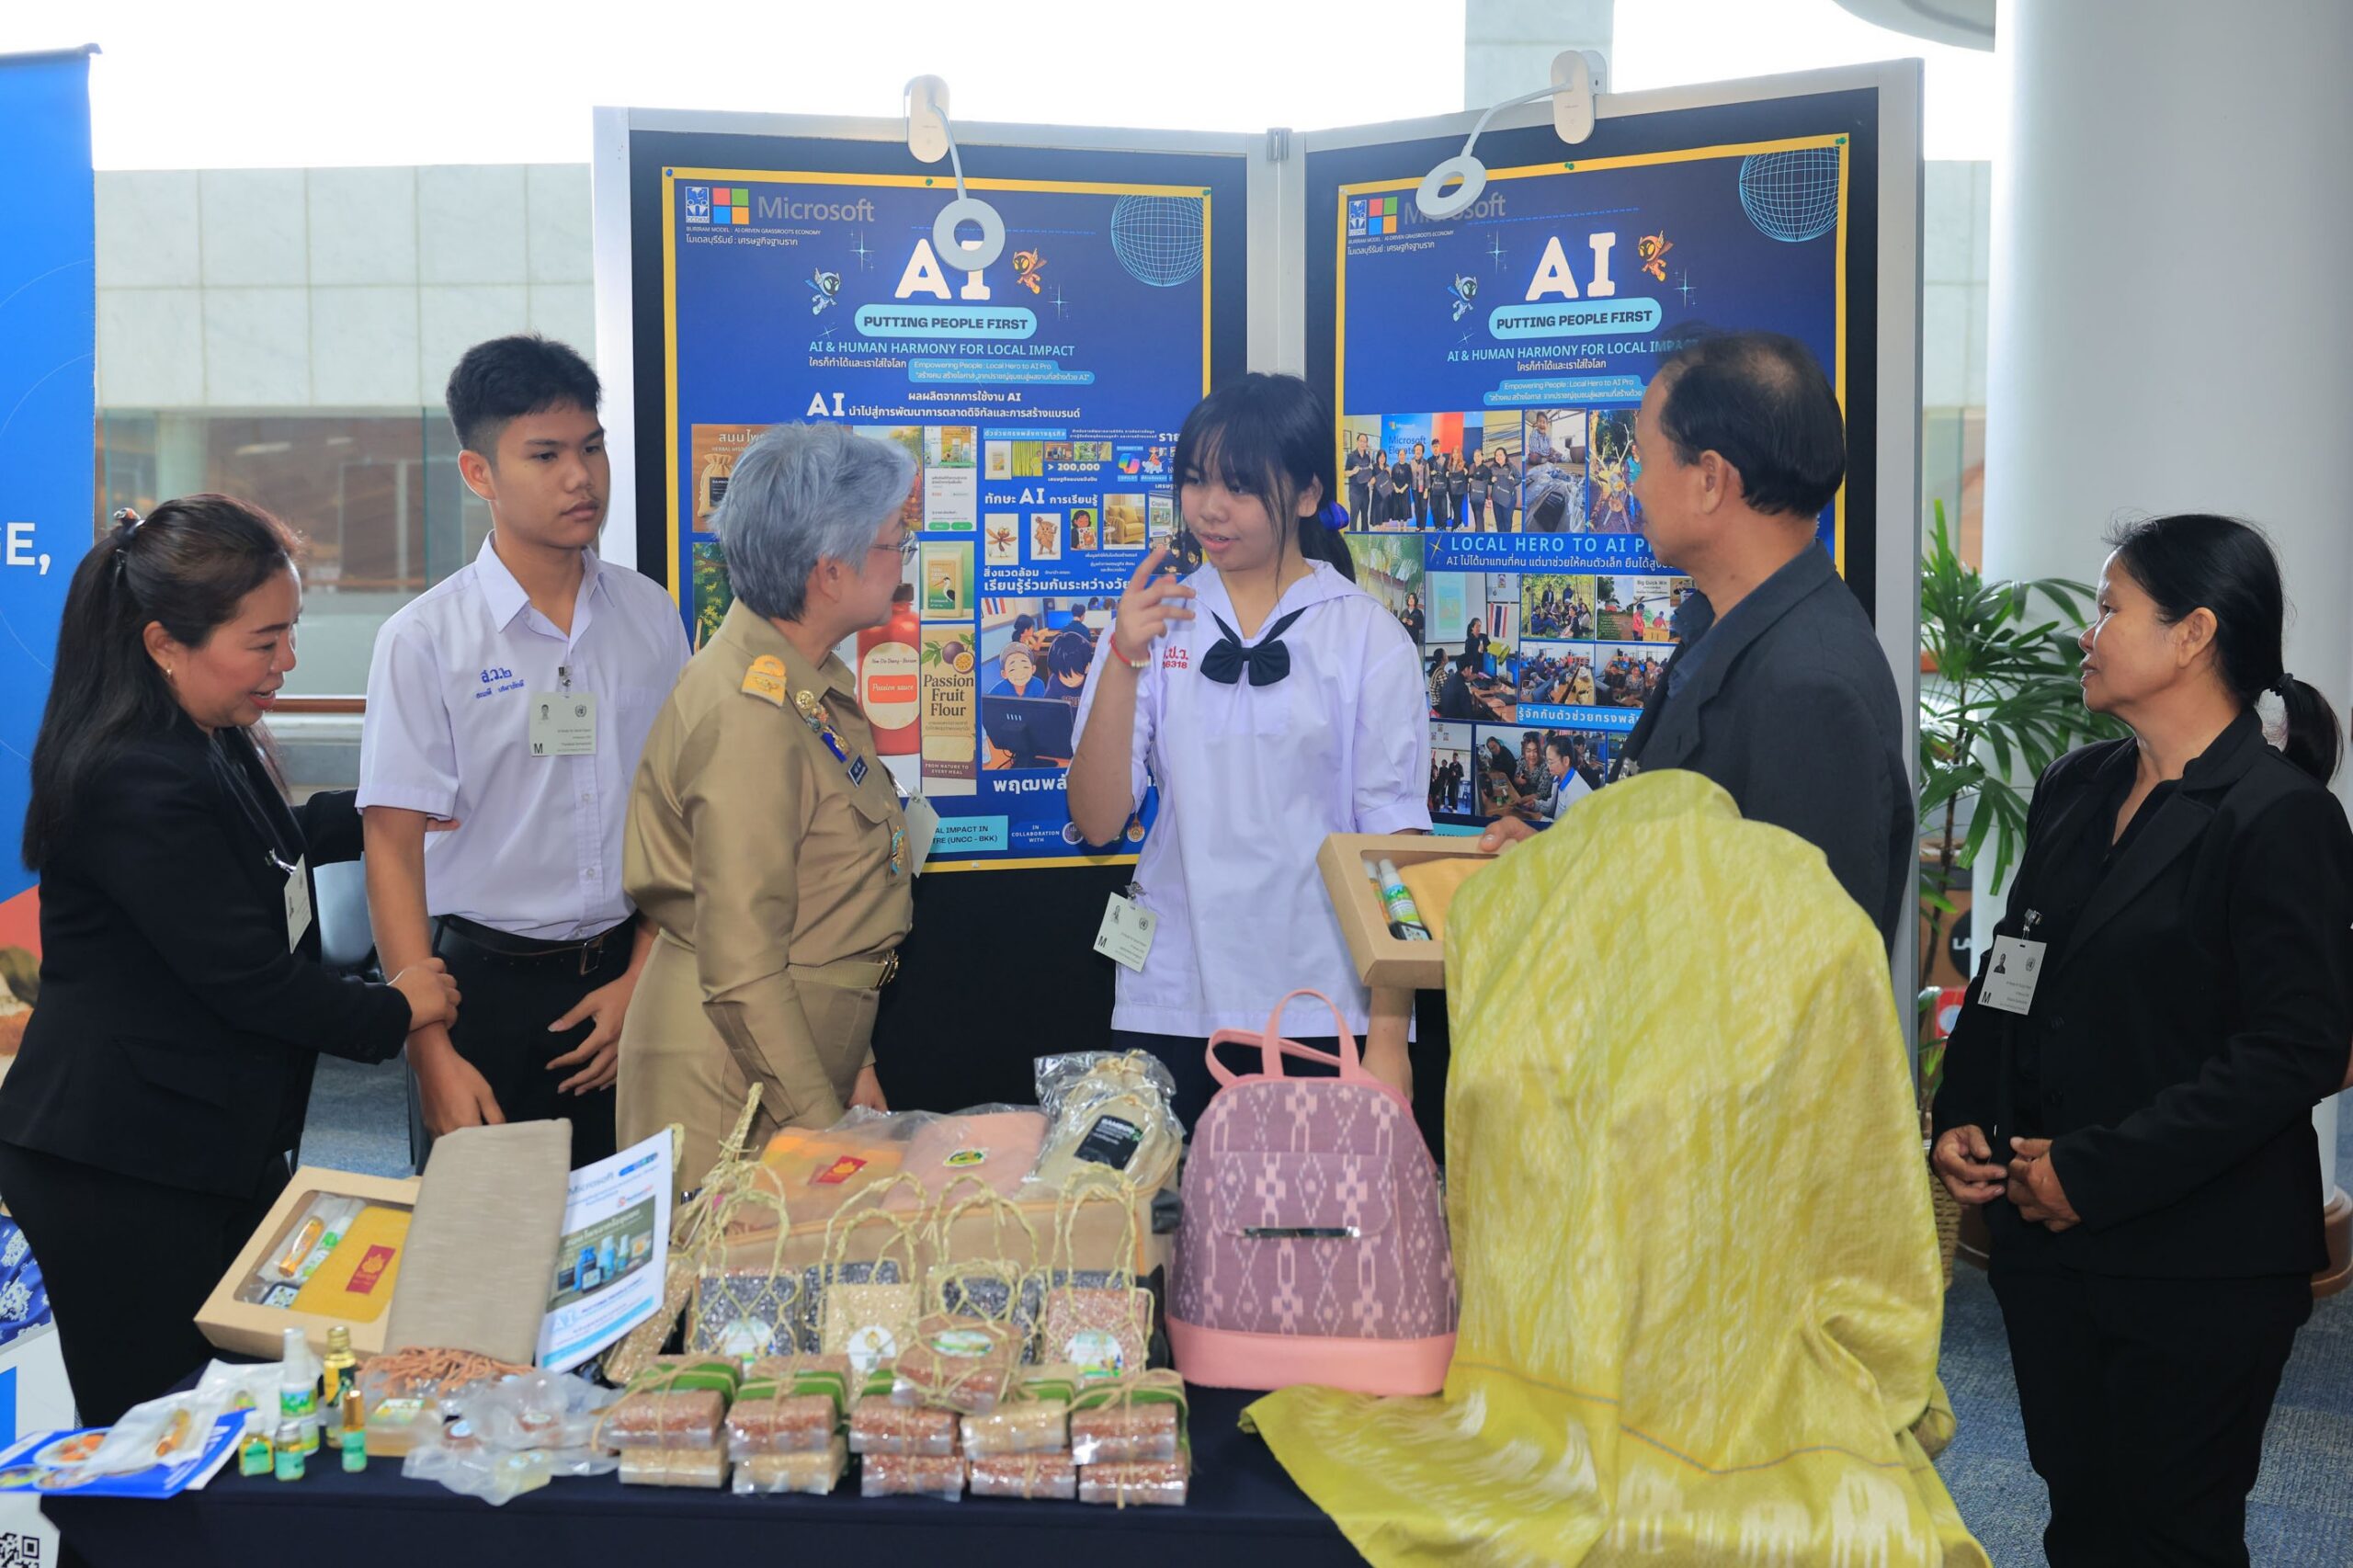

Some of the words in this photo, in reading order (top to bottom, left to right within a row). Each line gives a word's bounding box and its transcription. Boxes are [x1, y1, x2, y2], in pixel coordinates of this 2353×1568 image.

[757, 196, 875, 222] Microsoft
[1404, 232, 1432, 240] GRASSROOTS
[894, 238, 991, 301] AI
[1525, 231, 1617, 301] AI
[863, 315, 928, 328] PUTTING
[931, 317, 984, 329] PEOPLE
[987, 318, 1029, 330] FIRST
[1496, 315, 1556, 330] PUTTING
[1559, 312, 1608, 327] PEOPLE
[1610, 310, 1653, 324] FIRST
[809, 341, 824, 352] AI
[826, 341, 835, 353] &
[838, 342, 888, 353] HUMAN
[891, 343, 956, 355] HARMONY
[960, 344, 984, 355] FOR
[987, 345, 1026, 356] LOCAL
[1029, 346, 1074, 357] IMPACT
[1448, 351, 1460, 362] AI
[1461, 350, 1470, 361] &
[1472, 347, 1515, 360] HUMAN
[1518, 345, 1578, 358] HARMONY
[1581, 344, 1604, 356] FOR
[1608, 342, 1647, 355] LOCAL
[809, 357, 907, 369] ใครก็ทำได้และเราใส่ใจโลก
[914, 361, 959, 370] Empowering
[960, 362, 983, 370] People
[1505, 381, 1544, 391] Empowering
[1544, 380, 1566, 389] People
[1621, 378, 1634, 386] Pro
[908, 391, 1004, 403] ผลผลิตจากการใช้งาน
[1006, 392, 1021, 402] AI
[806, 392, 845, 416] AI
[1389, 435, 1427, 445] Microsoft
[1058, 463, 1100, 472] 200,000
[984, 493, 1017, 505] ทักษะ
[1019, 488, 1045, 505] AI
[1050, 494, 1098, 506] การเรียนรู้
[0, 522, 51, 575] E,
[1451, 537, 1507, 551] LOCAL
[1517, 537, 1563, 552] HERO
[1573, 538, 1597, 552] TO
[1607, 538, 1626, 552] AI
[1447, 558, 1459, 566] AI
[1460, 553, 1527, 567] ไม่ได้มาแทนที่คน
[1529, 555, 1622, 568] แต่มาช่วยให้คนตัวเล็ก
[983, 566, 1039, 577] สิ่งแวดล้อม
[1164, 645, 1188, 660] .ป.ว.
[872, 683, 895, 692] Passion
[924, 675, 974, 687] Passion
[931, 688, 965, 701] Fruit
[931, 703, 966, 716] Flour
[1518, 706, 1640, 724] รู้จักกับตัวช่วยทรงพลั
[533, 743, 543, 754] M
[994, 775, 1068, 794] พฤฒพลั
[946, 825, 978, 834] IMPACT
[933, 836, 946, 845] TRE
[948, 835, 973, 845] (UNCC
[980, 835, 998, 843] BKK)
[1097, 936, 1108, 948] M
[1952, 937, 1972, 950] LA
[1982, 991, 1992, 1004] M
